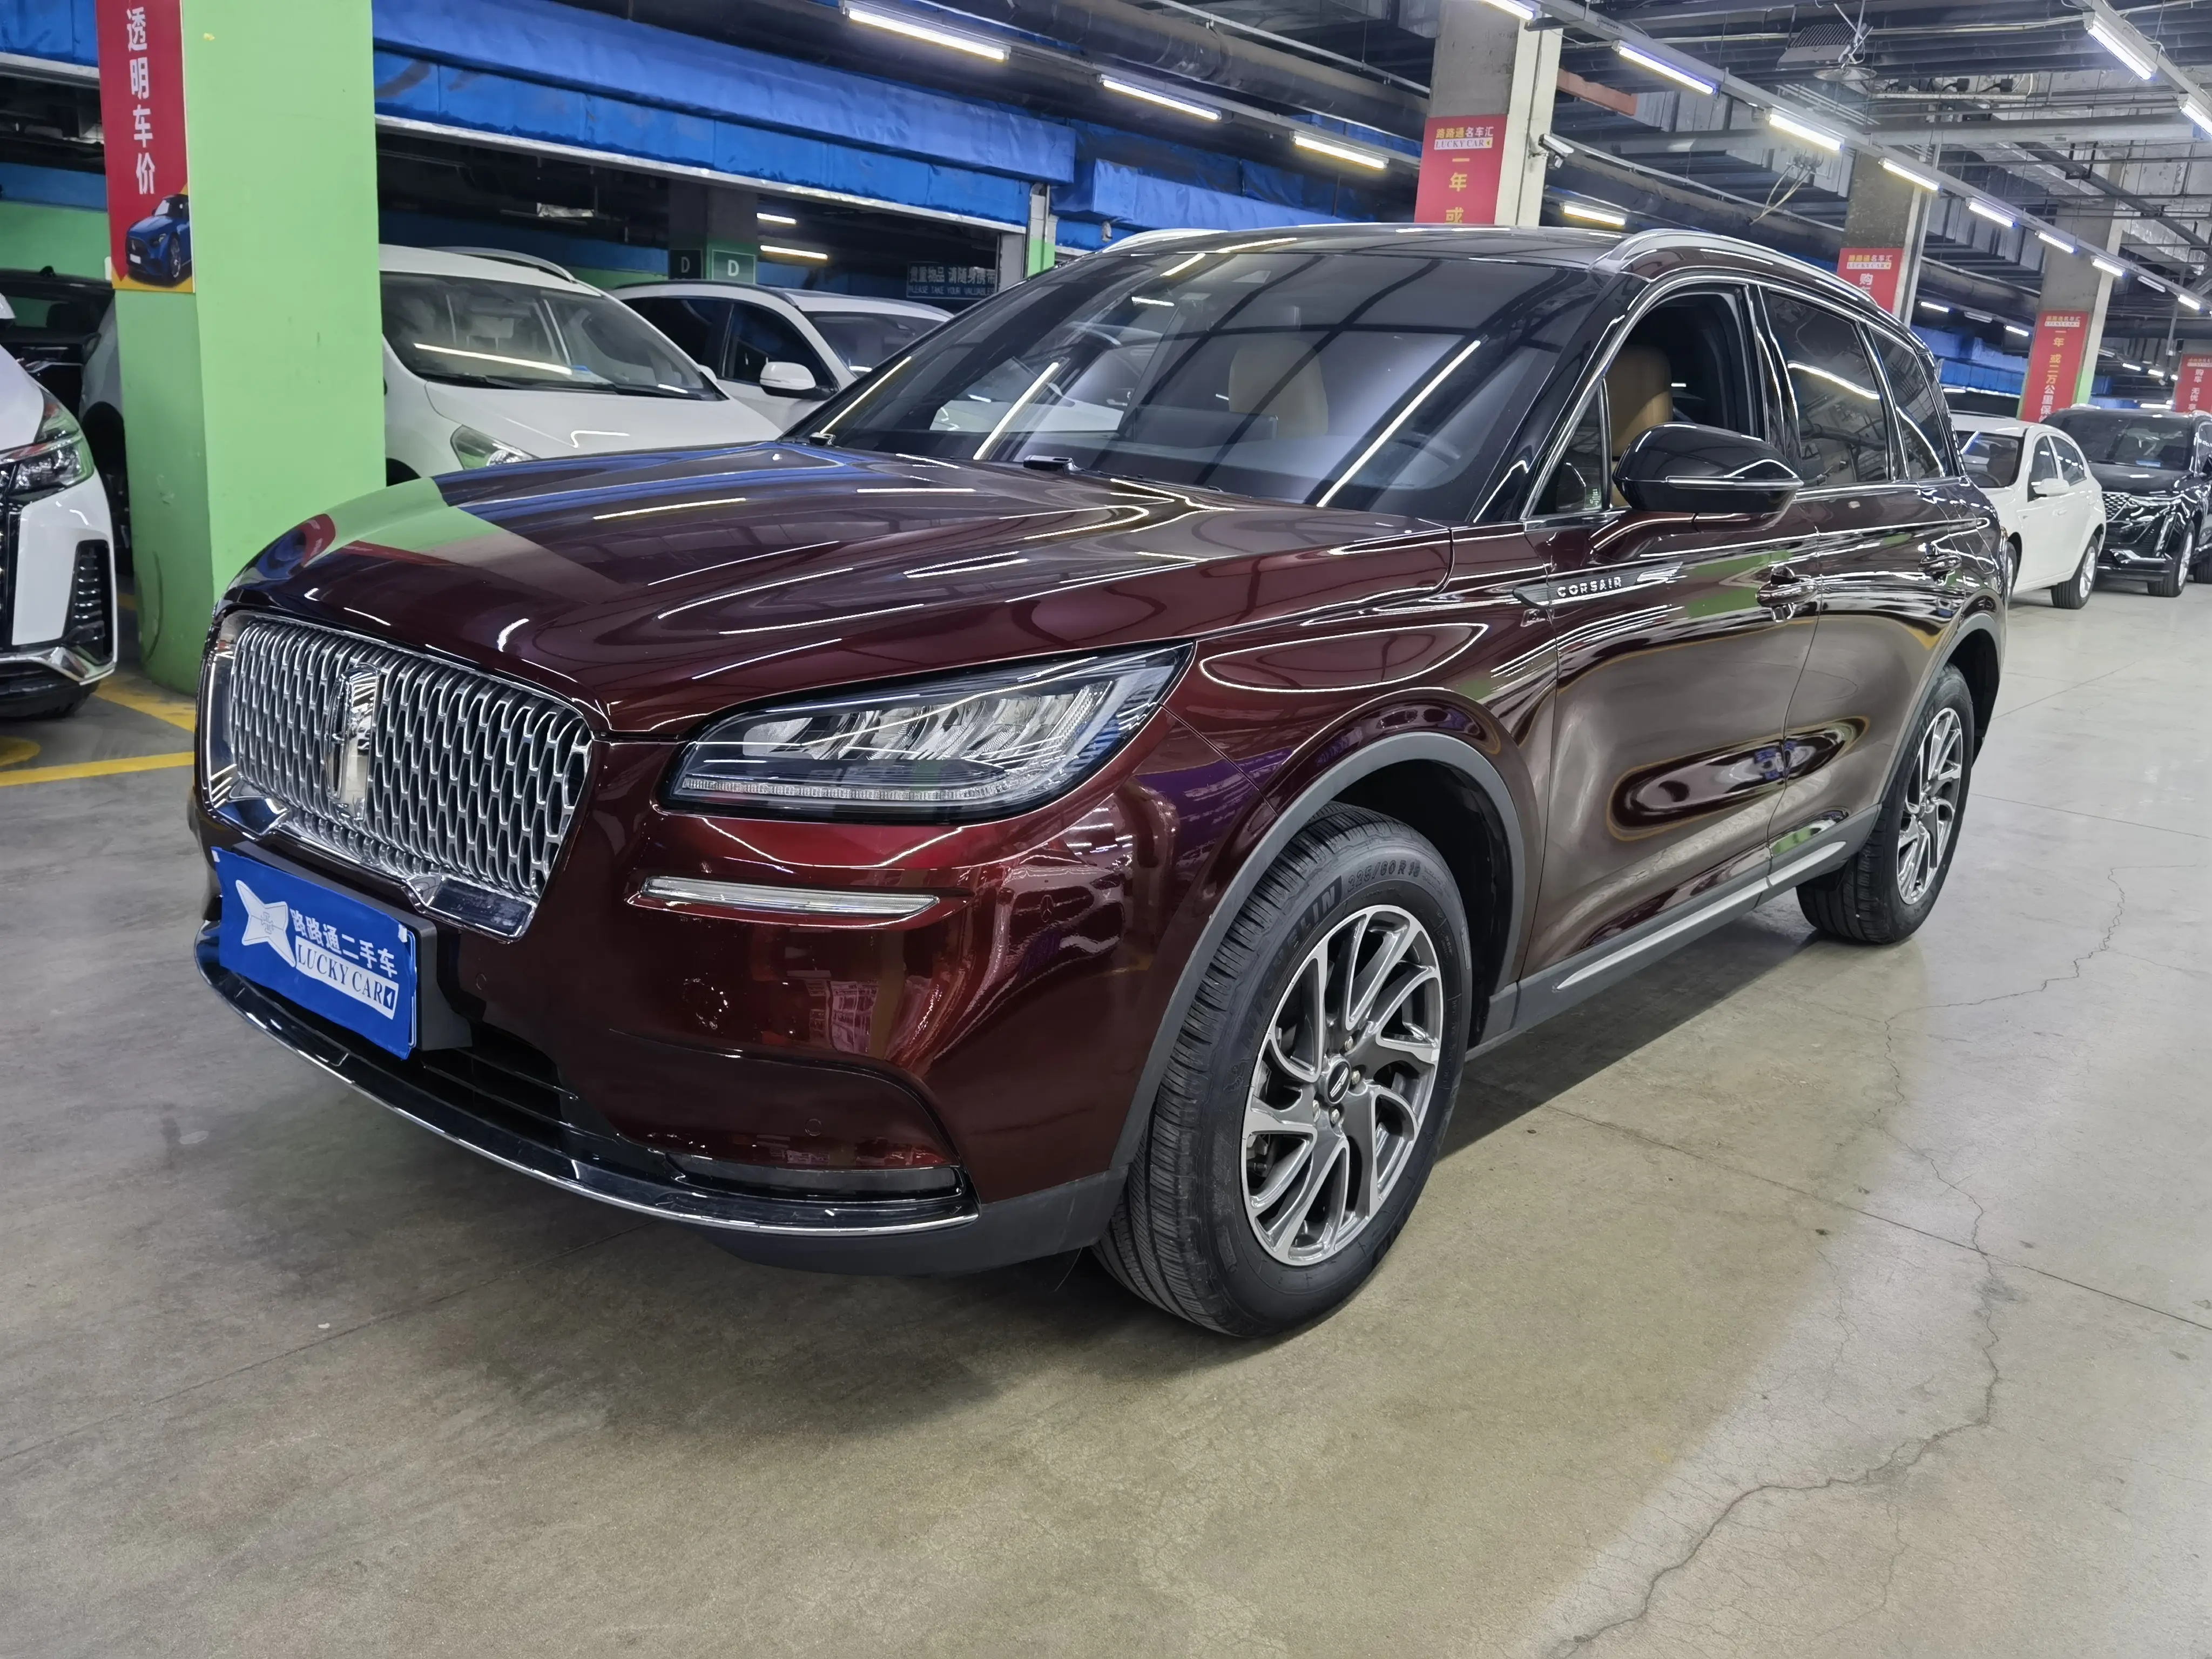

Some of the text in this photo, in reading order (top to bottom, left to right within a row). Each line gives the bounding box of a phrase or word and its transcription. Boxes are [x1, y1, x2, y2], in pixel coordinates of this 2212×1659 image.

[126, 6, 156, 195] 透明车价
[1435, 126, 1494, 139] 路路通名车汇
[1435, 139, 1485, 149] LUCKY CAR
[681, 256, 690, 273] D
[728, 259, 739, 276] D
[1557, 577, 1622, 597] CORSAIR
[290, 908, 398, 978] 路路通二手车
[297, 943, 383, 1004] LUCKY CAR
